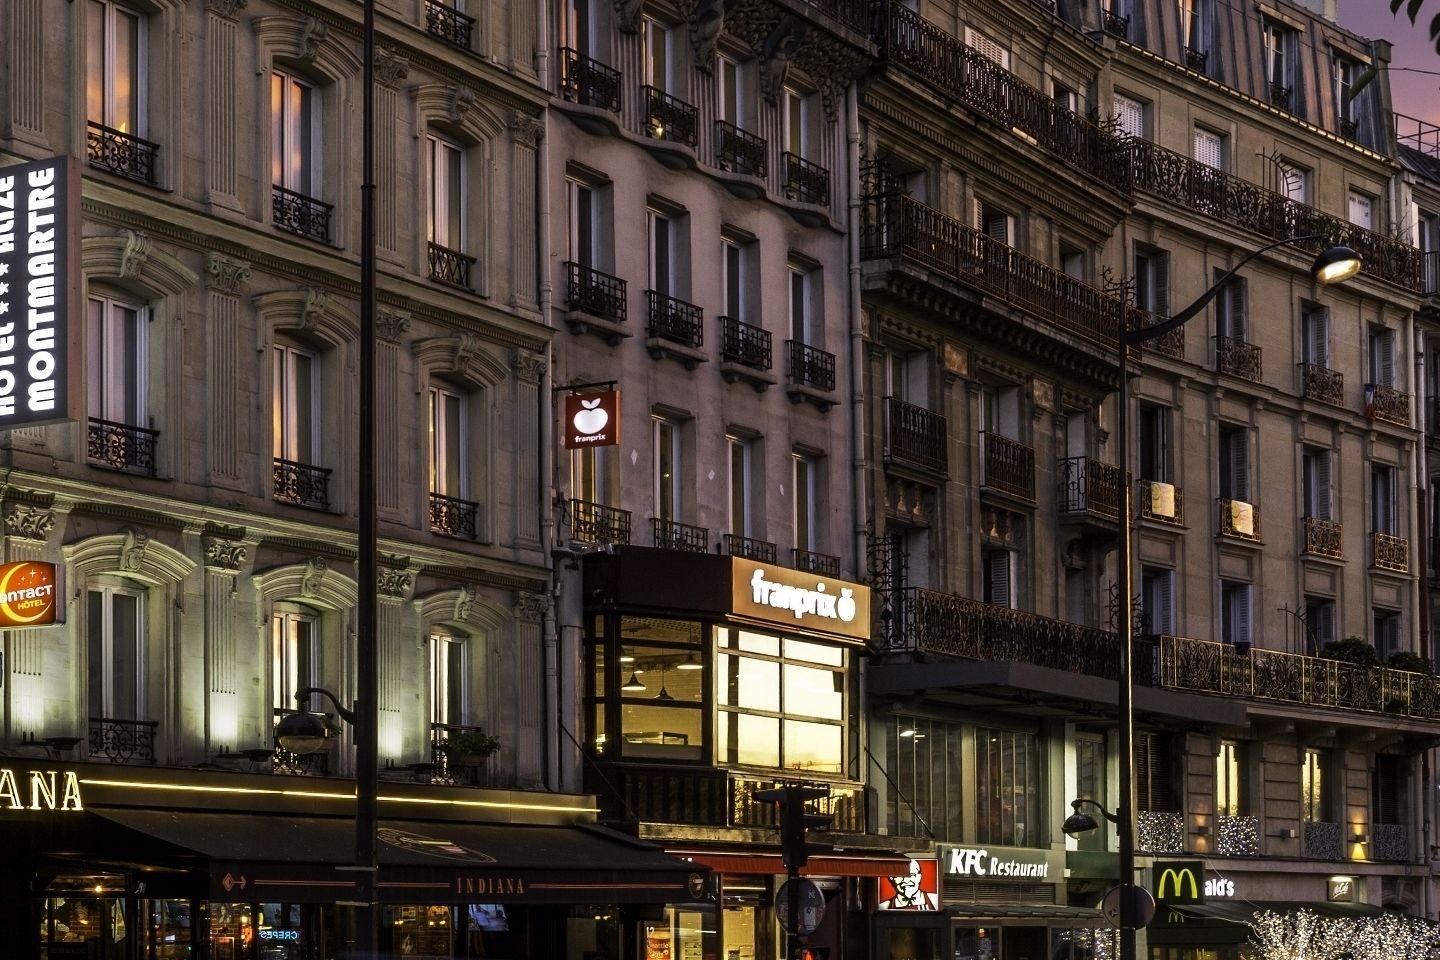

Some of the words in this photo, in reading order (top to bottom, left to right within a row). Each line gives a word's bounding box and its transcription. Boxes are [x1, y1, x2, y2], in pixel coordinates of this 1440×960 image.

[27, 167, 56, 412] MONTMARTRE
[574, 434, 606, 443] franprix
[751, 568, 838, 619] franprix
[949, 848, 988, 875] KFC
[990, 857, 1049, 878] Restaurant
[457, 878, 524, 894] INDIANA
